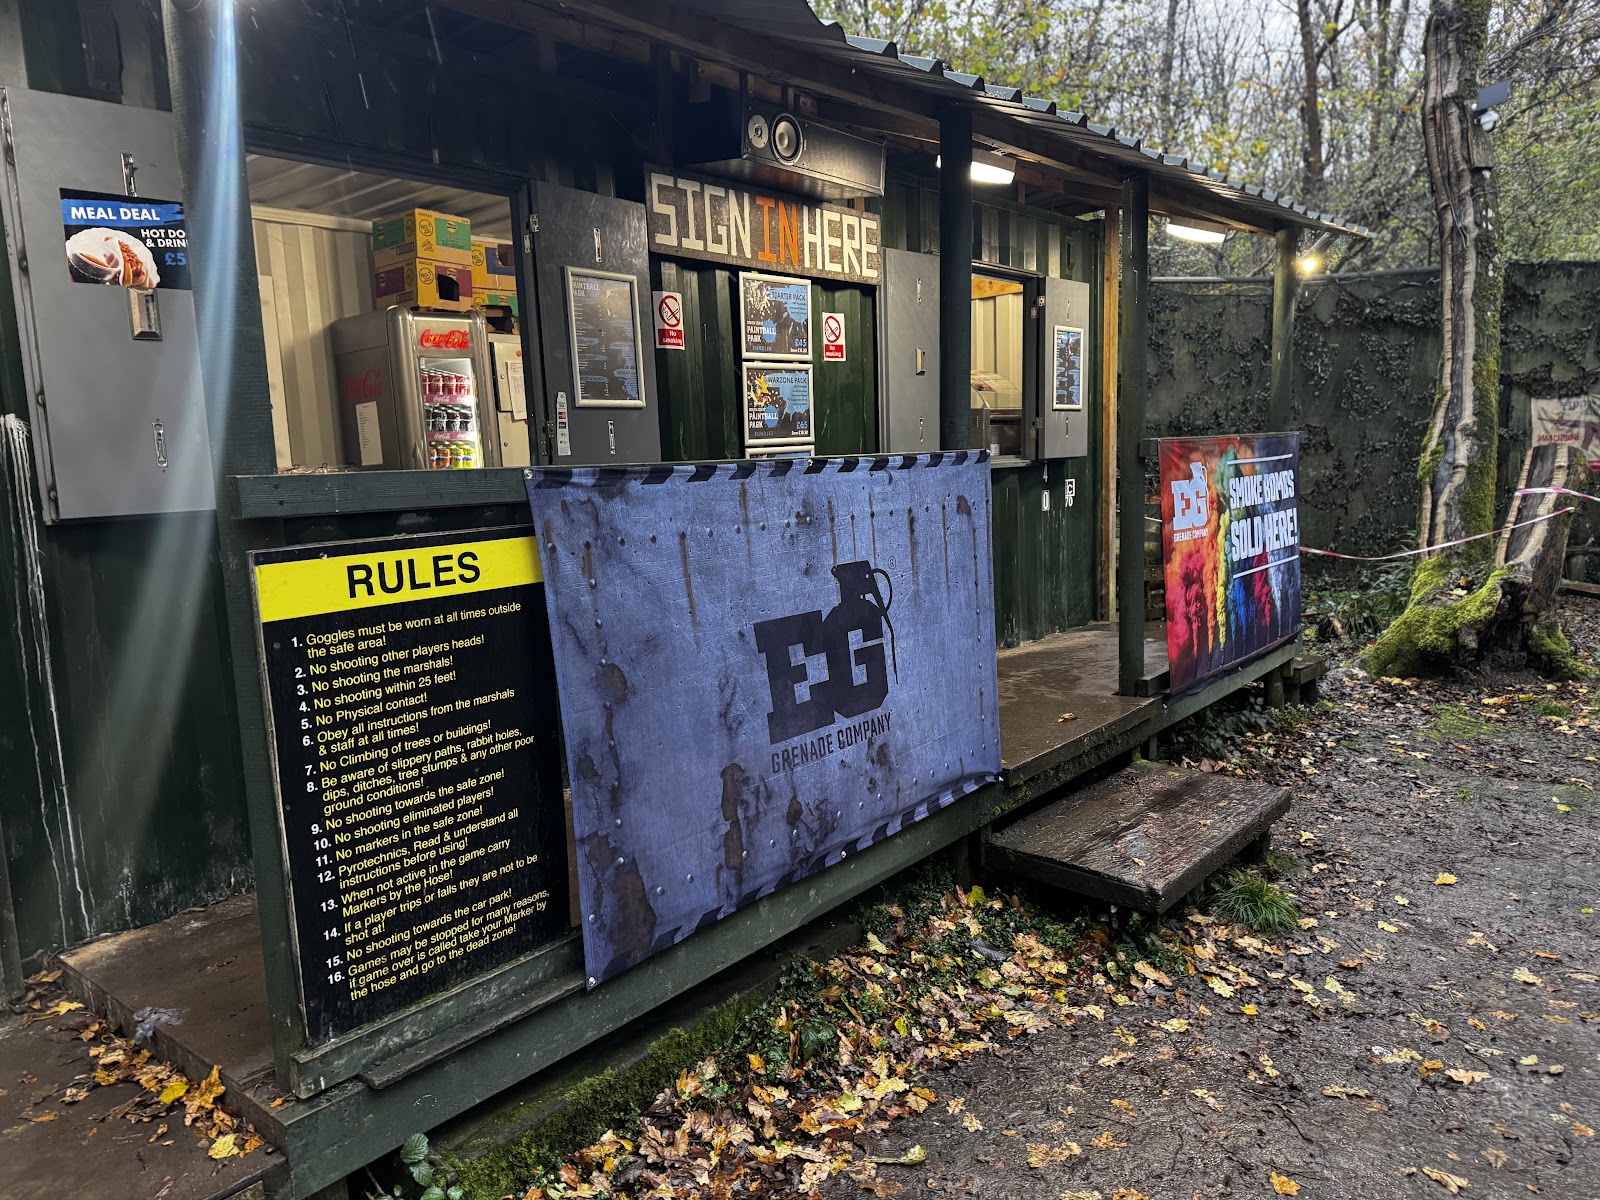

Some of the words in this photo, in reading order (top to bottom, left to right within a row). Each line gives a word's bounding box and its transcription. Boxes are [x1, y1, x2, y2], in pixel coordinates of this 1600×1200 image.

[71, 206, 117, 220] MEAL
[119, 208, 160, 220] DEAL
[650, 172, 752, 259] SIGN
[756, 196, 798, 266] IN
[803, 206, 878, 278] HERE
[140, 228, 166, 238] HOT
[168, 229, 186, 238] DO
[146, 239, 155, 248] &
[157, 239, 188, 248] DRIN
[164, 252, 186, 266] £5
[772, 291, 792, 300] STARTER
[420, 328, 470, 350] Coca-Cola
[747, 326, 776, 334] PAINTBALL
[794, 338, 807, 347] £45
[796, 421, 808, 429] £65
[1065, 496, 1073, 508] 70
[1171, 472, 1208, 531] EG
[1229, 474, 1263, 510] SMOKE
[1264, 470, 1294, 505] BOMBS
[1174, 530, 1191, 542] GRENADE
[1192, 528, 1209, 540] COMPANY
[1231, 516, 1264, 562] SOLD
[1264, 508, 1298, 552] HERE!
[346, 552, 482, 598] RULES
[292, 637, 302, 647] 1.
[306, 630, 355, 645] Goggles
[358, 623, 386, 636] must
[388, 622, 402, 631] be
[405, 618, 431, 628] worn
[434, 614, 444, 624] at
[447, 612, 458, 622] all
[460, 609, 486, 620] times
[489, 602, 521, 615] outside
[295, 667, 306, 678] 2.
[310, 664, 327, 675] No
[330, 656, 378, 672] shooting
[382, 650, 409, 662] other
[412, 643, 449, 659] players
[452, 634, 484, 649] heads!
[307, 648, 326, 658] the
[330, 642, 354, 654] safe
[358, 636, 386, 650] area!
[297, 684, 308, 695] 3.
[312, 681, 329, 692] No
[332, 672, 380, 688] shooting
[383, 668, 400, 678] the
[404, 656, 452, 674] marshals!
[753, 592, 890, 745] EG
[299, 702, 310, 712] 4.
[314, 698, 331, 709] No
[334, 688, 382, 705] shooting
[385, 680, 415, 694] within
[419, 676, 431, 687] 25
[434, 670, 456, 684] feet!
[301, 718, 312, 729] 5.
[316, 715, 332, 726] No
[336, 702, 382, 721] Physical
[386, 692, 428, 710] contact!
[303, 735, 314, 746] 6.
[318, 729, 348, 742] Obey
[352, 723, 364, 735] all
[368, 710, 428, 731] instructions
[430, 704, 453, 716] from
[456, 700, 470, 710] the
[474, 689, 514, 705] marshals
[319, 745, 327, 756] &
[331, 738, 354, 752] staff
[358, 735, 368, 746] at
[372, 731, 384, 742] all
[387, 722, 419, 739] times!
[771, 733, 834, 774] GRENADE
[837, 711, 892, 750] COMPANY
[307, 782, 318, 792] 8.
[322, 777, 337, 788] Be
[341, 768, 374, 783] aware
[378, 762, 388, 773] of
[392, 752, 431, 770] slippery
[435, 745, 464, 760] paths,
[467, 734, 493, 749] rabbit
[496, 729, 522, 741] holes,
[323, 788, 349, 801] dips,
[353, 776, 395, 793] ditches,
[398, 769, 419, 780] tree
[422, 758, 458, 774] stumps
[461, 753, 467, 763] &
[471, 749, 487, 760] any
[490, 742, 512, 754] other
[515, 736, 534, 749] poor
[324, 794, 363, 816] ground
[367, 777, 423, 802] conditions!
[328, 971, 345, 984] 16.
[348, 956, 387, 976] Games
[390, 945, 412, 960] may
[415, 939, 427, 950] be
[431, 920, 469, 943] stopped
[472, 916, 484, 926] for
[486, 905, 510, 920] many
[514, 890, 549, 909] reasons,
[350, 978, 356, 988] if
[359, 967, 388, 987] game
[392, 956, 414, 971] over
[417, 952, 426, 960] is
[428, 937, 457, 956] called
[460, 930, 479, 943] take
[482, 920, 502, 936] your
[504, 906, 534, 924] Marker
[536, 901, 546, 911] by
[350, 988, 368, 1000] the
[371, 976, 396, 992] hose
[400, 964, 418, 980] and
[422, 960, 434, 973] go
[437, 955, 446, 964] to
[449, 948, 464, 959] the
[466, 935, 489, 952] dead
[492, 923, 516, 941] zone!
